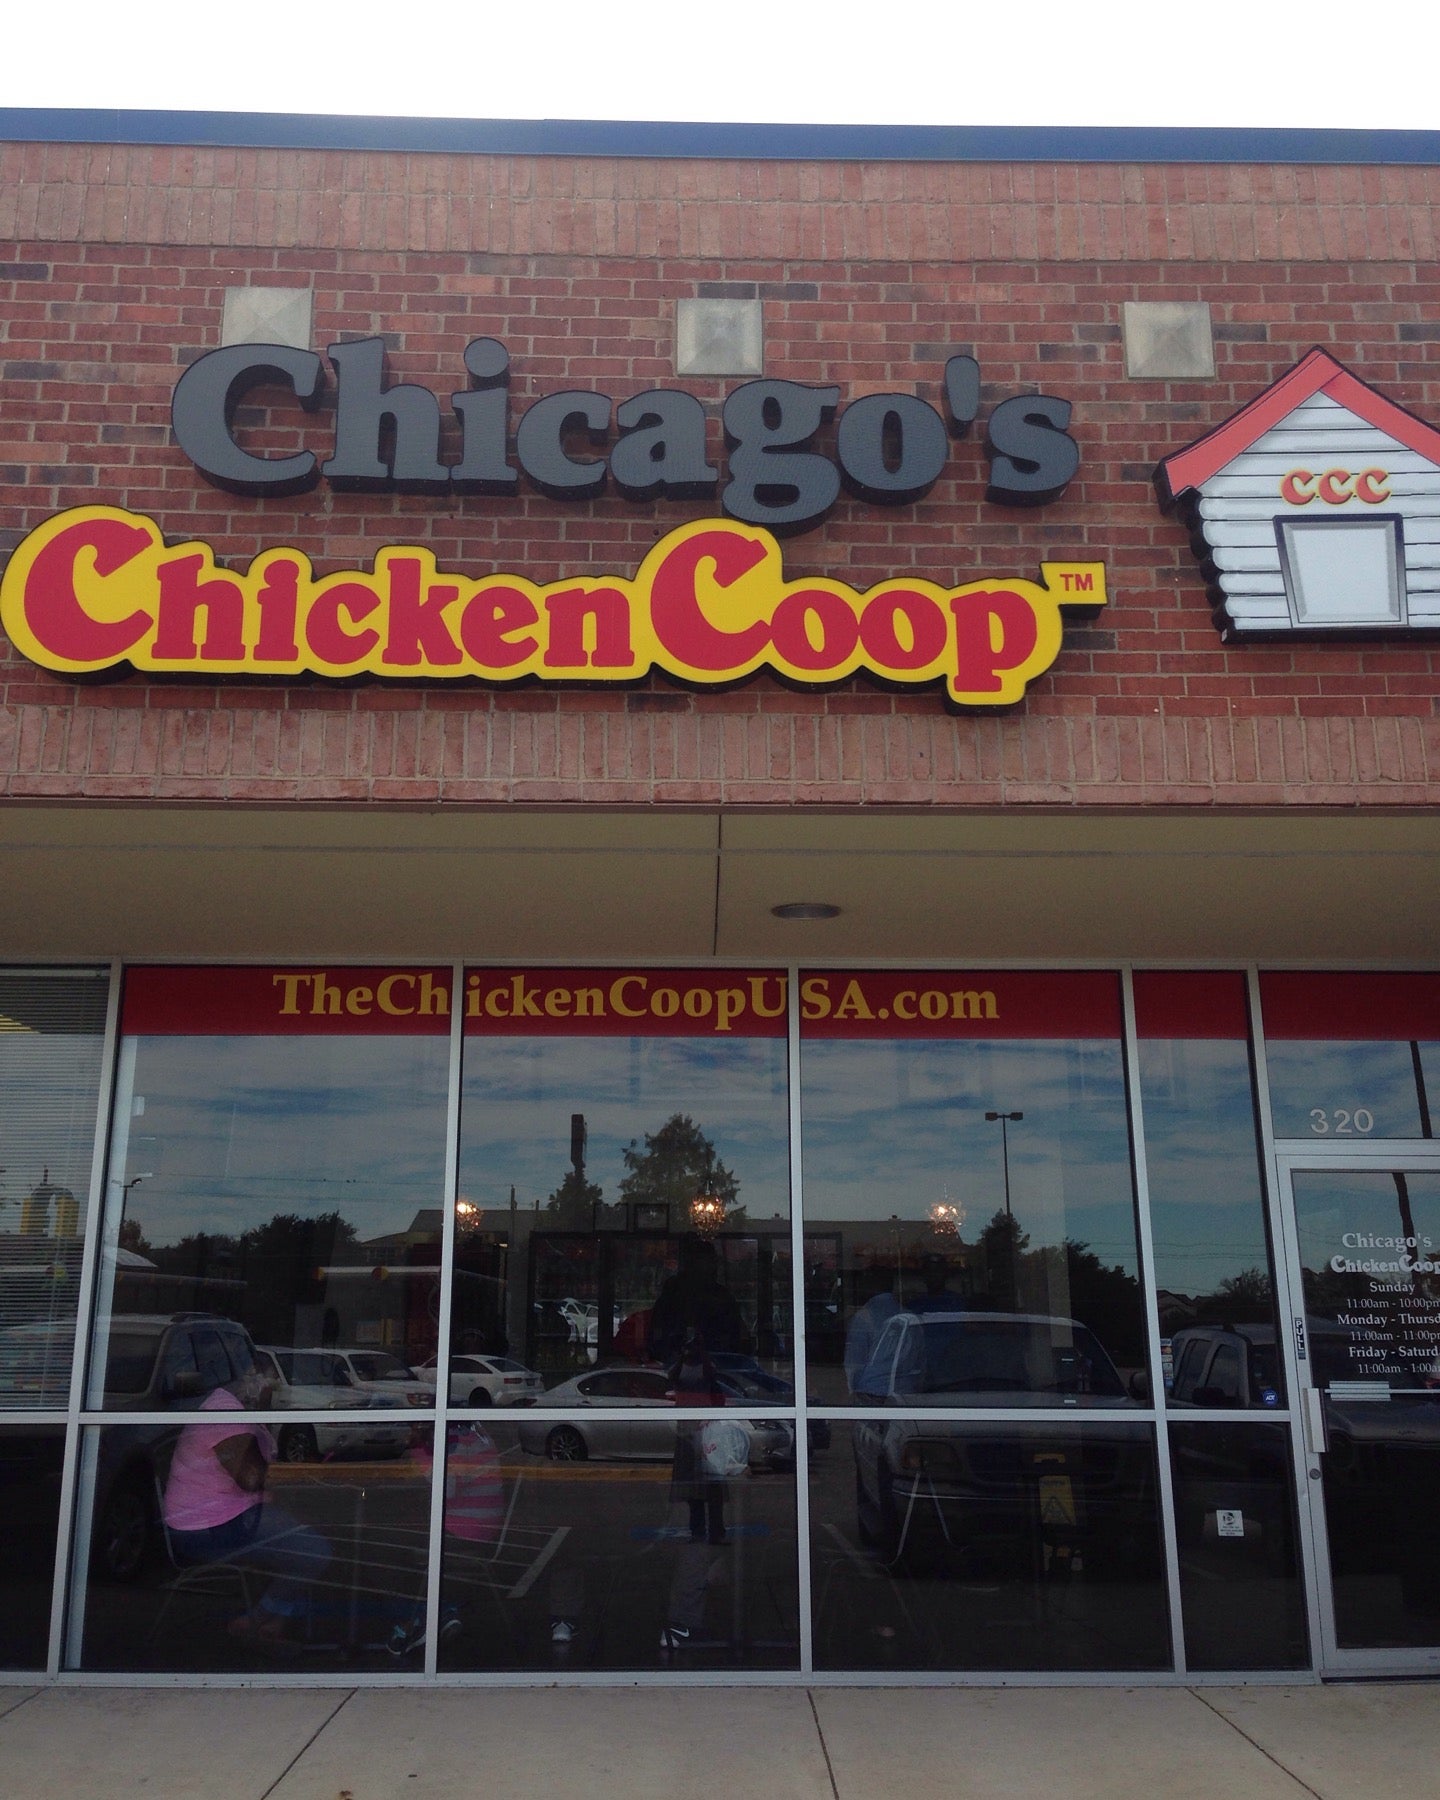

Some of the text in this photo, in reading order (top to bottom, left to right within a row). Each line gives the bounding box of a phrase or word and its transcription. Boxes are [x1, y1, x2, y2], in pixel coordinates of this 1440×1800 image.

[171, 337, 1078, 523] Chicago's
[1059, 572, 1094, 592] TM
[272, 972, 1000, 1032] TheChickenCoopUSA.com
[1309, 1108, 1374, 1134] 320
[1342, 1232, 1432, 1253] Chicago's
[1369, 1281, 1415, 1296] Sunday
[1347, 1298, 1390, 1309] 11:00am
[1337, 1314, 1388, 1328] Monday
[1295, 1320, 1305, 1350] PULL
[1351, 1330, 1393, 1341] 11:00am
[1349, 1346, 1388, 1360] Friday
[1398, 1345, 1440, 1357] Saturd
[1358, 1363, 1401, 1374] 11:00am
